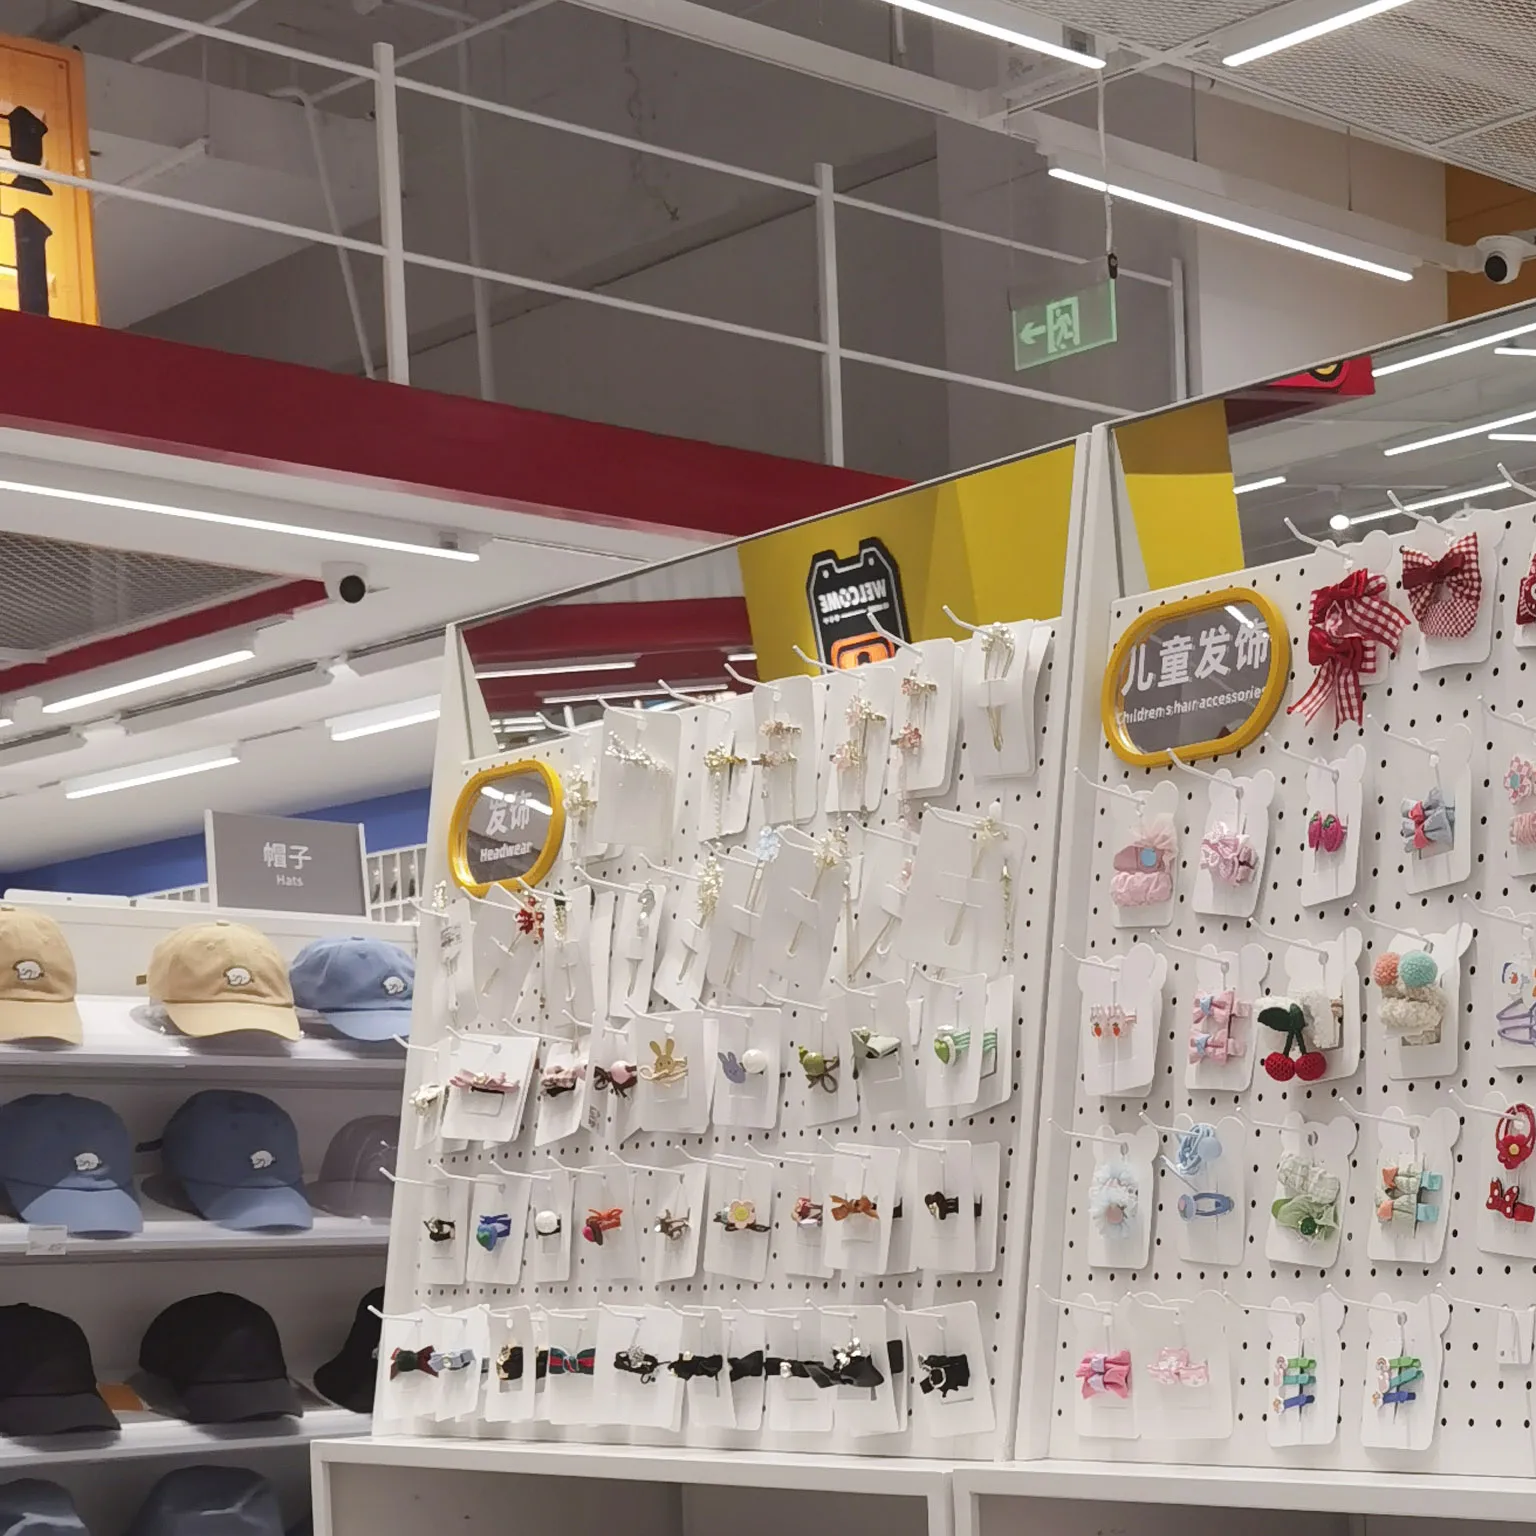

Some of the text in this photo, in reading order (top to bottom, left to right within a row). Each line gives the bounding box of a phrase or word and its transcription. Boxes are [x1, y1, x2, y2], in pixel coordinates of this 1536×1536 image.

[1121, 619, 1269, 696] 儿童发饰
[1173, 699, 1195, 715] hair
[263, 841, 312, 870] 帽子
[480, 841, 533, 862] Headwear
[276, 874, 304, 887] Hats
